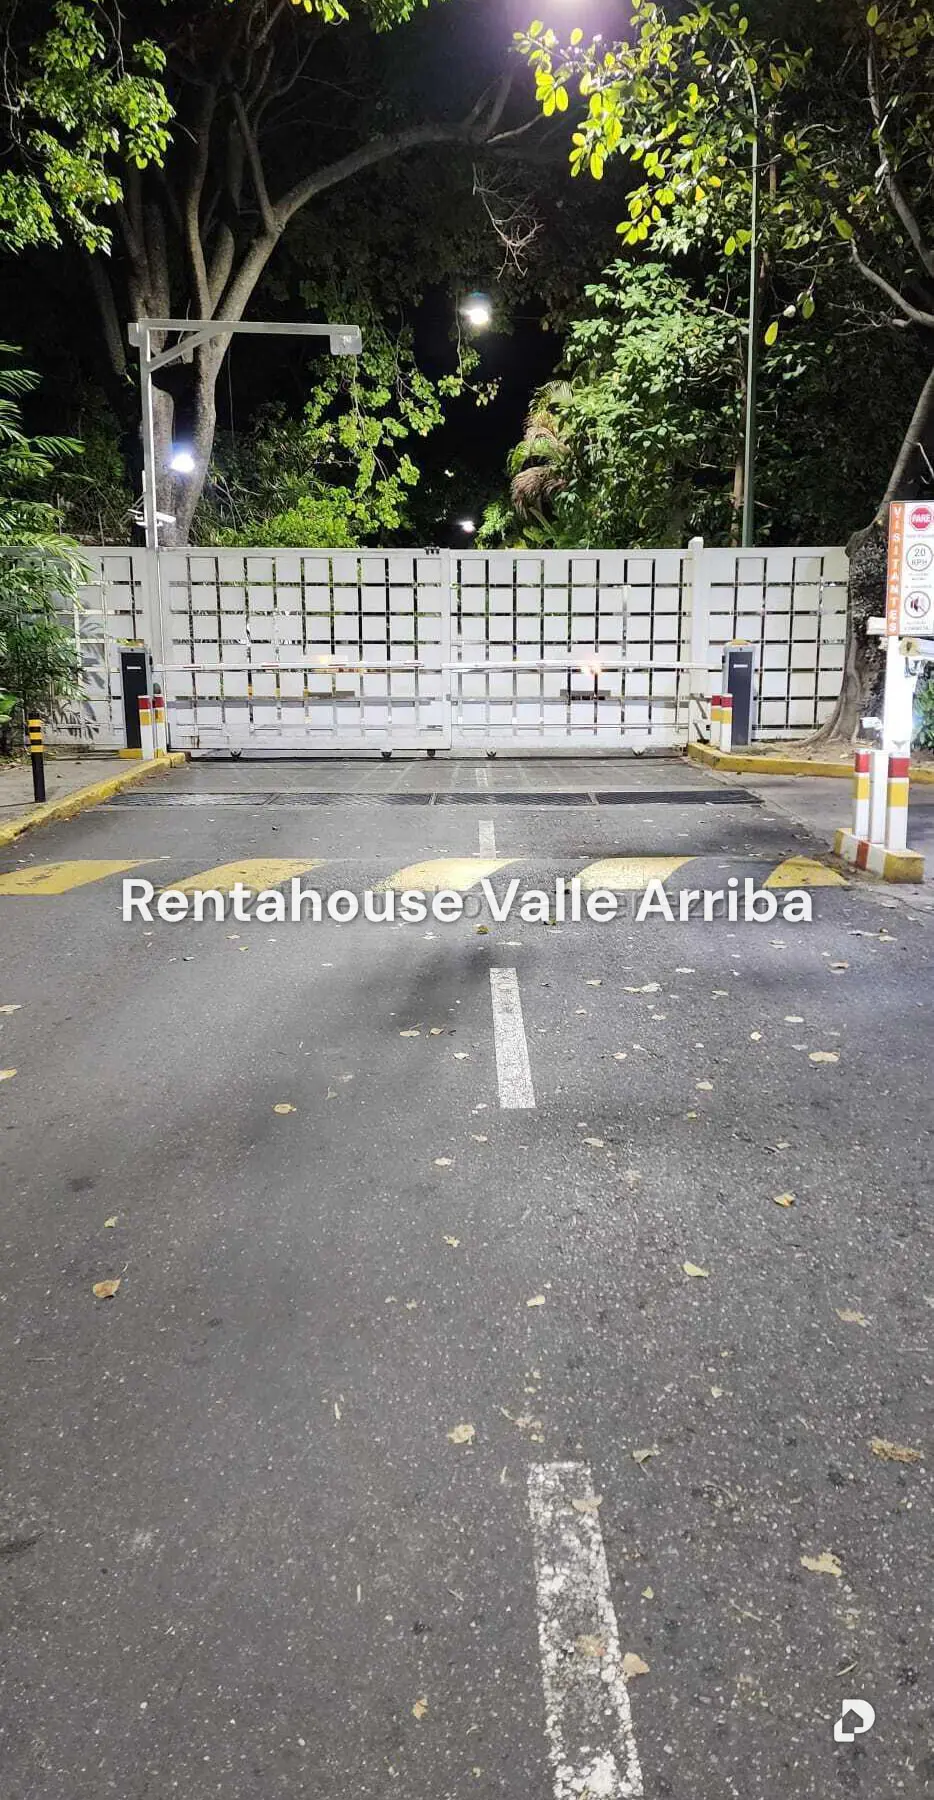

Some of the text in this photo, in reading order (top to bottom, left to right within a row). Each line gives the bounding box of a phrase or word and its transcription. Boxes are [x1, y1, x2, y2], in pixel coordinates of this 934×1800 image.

[911, 514, 932, 523] PARE
[914, 548, 926, 557] 20
[888, 506, 902, 632] VISITANTES
